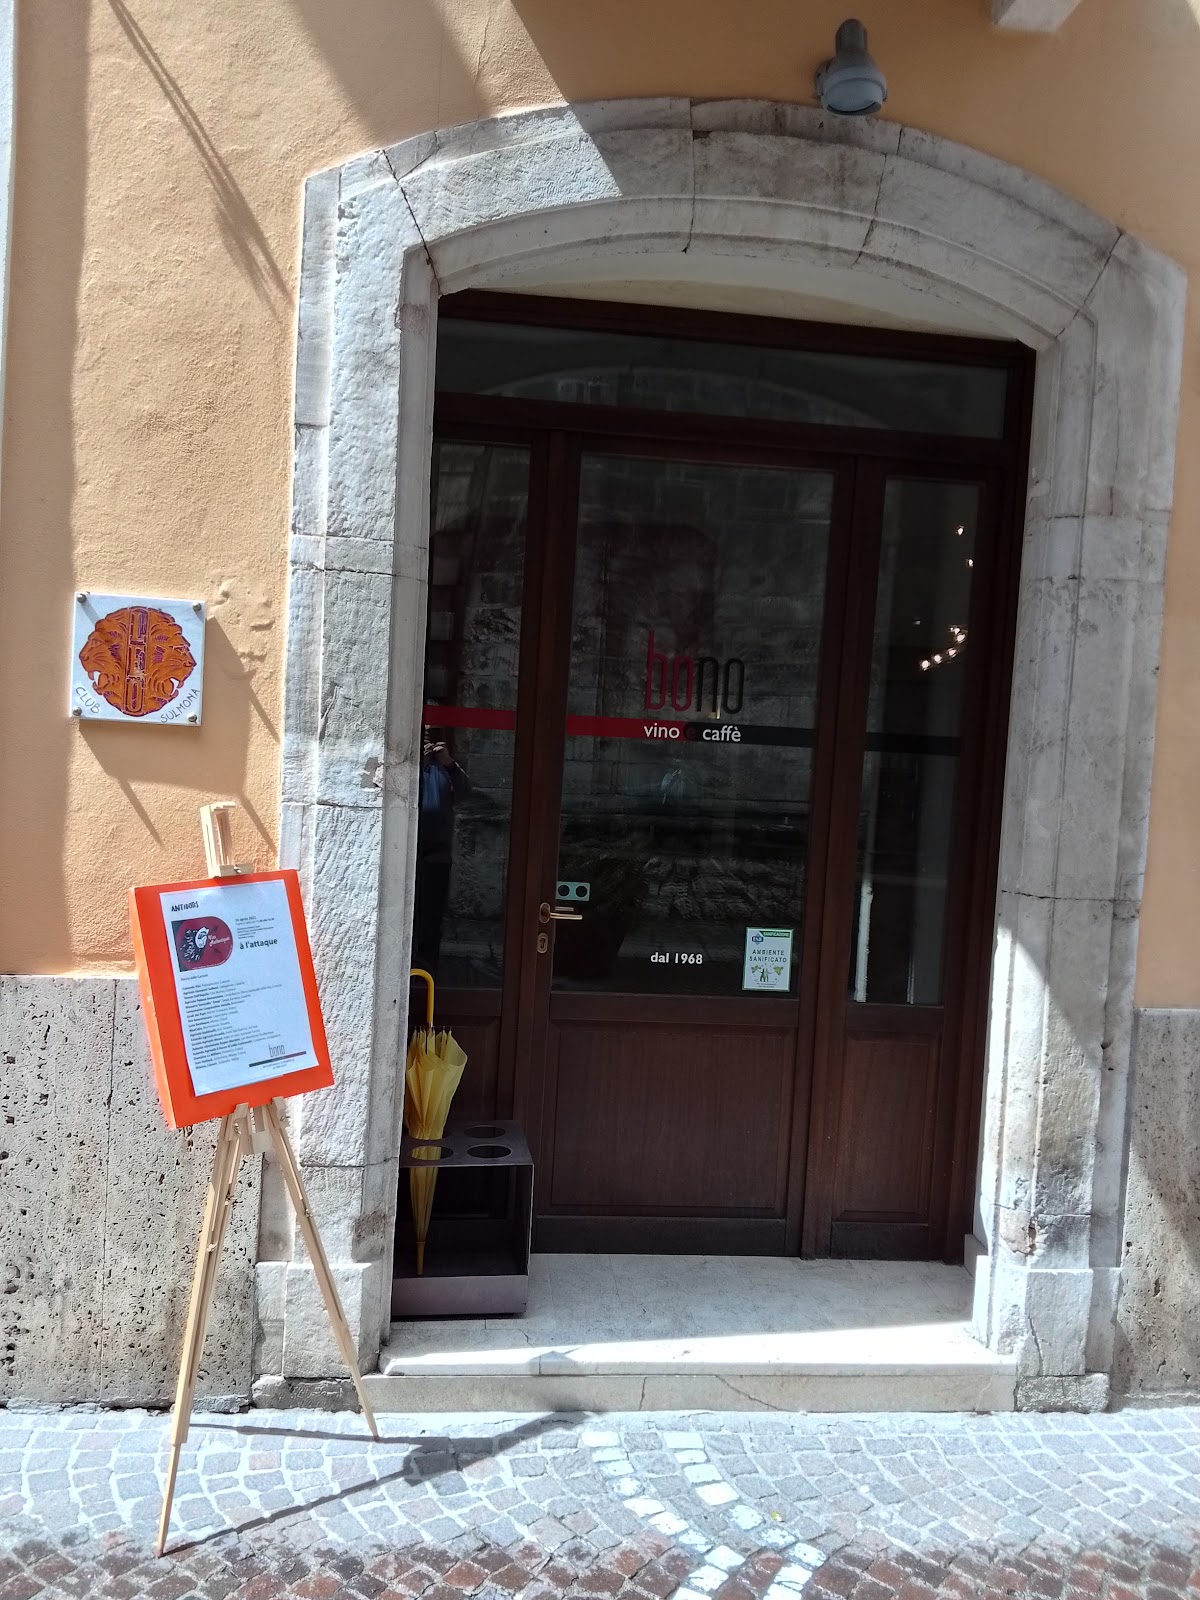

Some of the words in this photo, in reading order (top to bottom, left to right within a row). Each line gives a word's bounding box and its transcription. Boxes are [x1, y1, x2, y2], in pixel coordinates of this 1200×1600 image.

[645, 629, 745, 714] bono
[75, 686, 100, 714] CLUB
[160, 688, 200, 723] SULMONA
[643, 722, 680, 739] vino
[702, 724, 742, 742] caffè
[240, 941, 244, 950] à
[246, 938, 278, 949] l'attaque
[650, 951, 670, 963] dal
[675, 952, 703, 965] 1968
